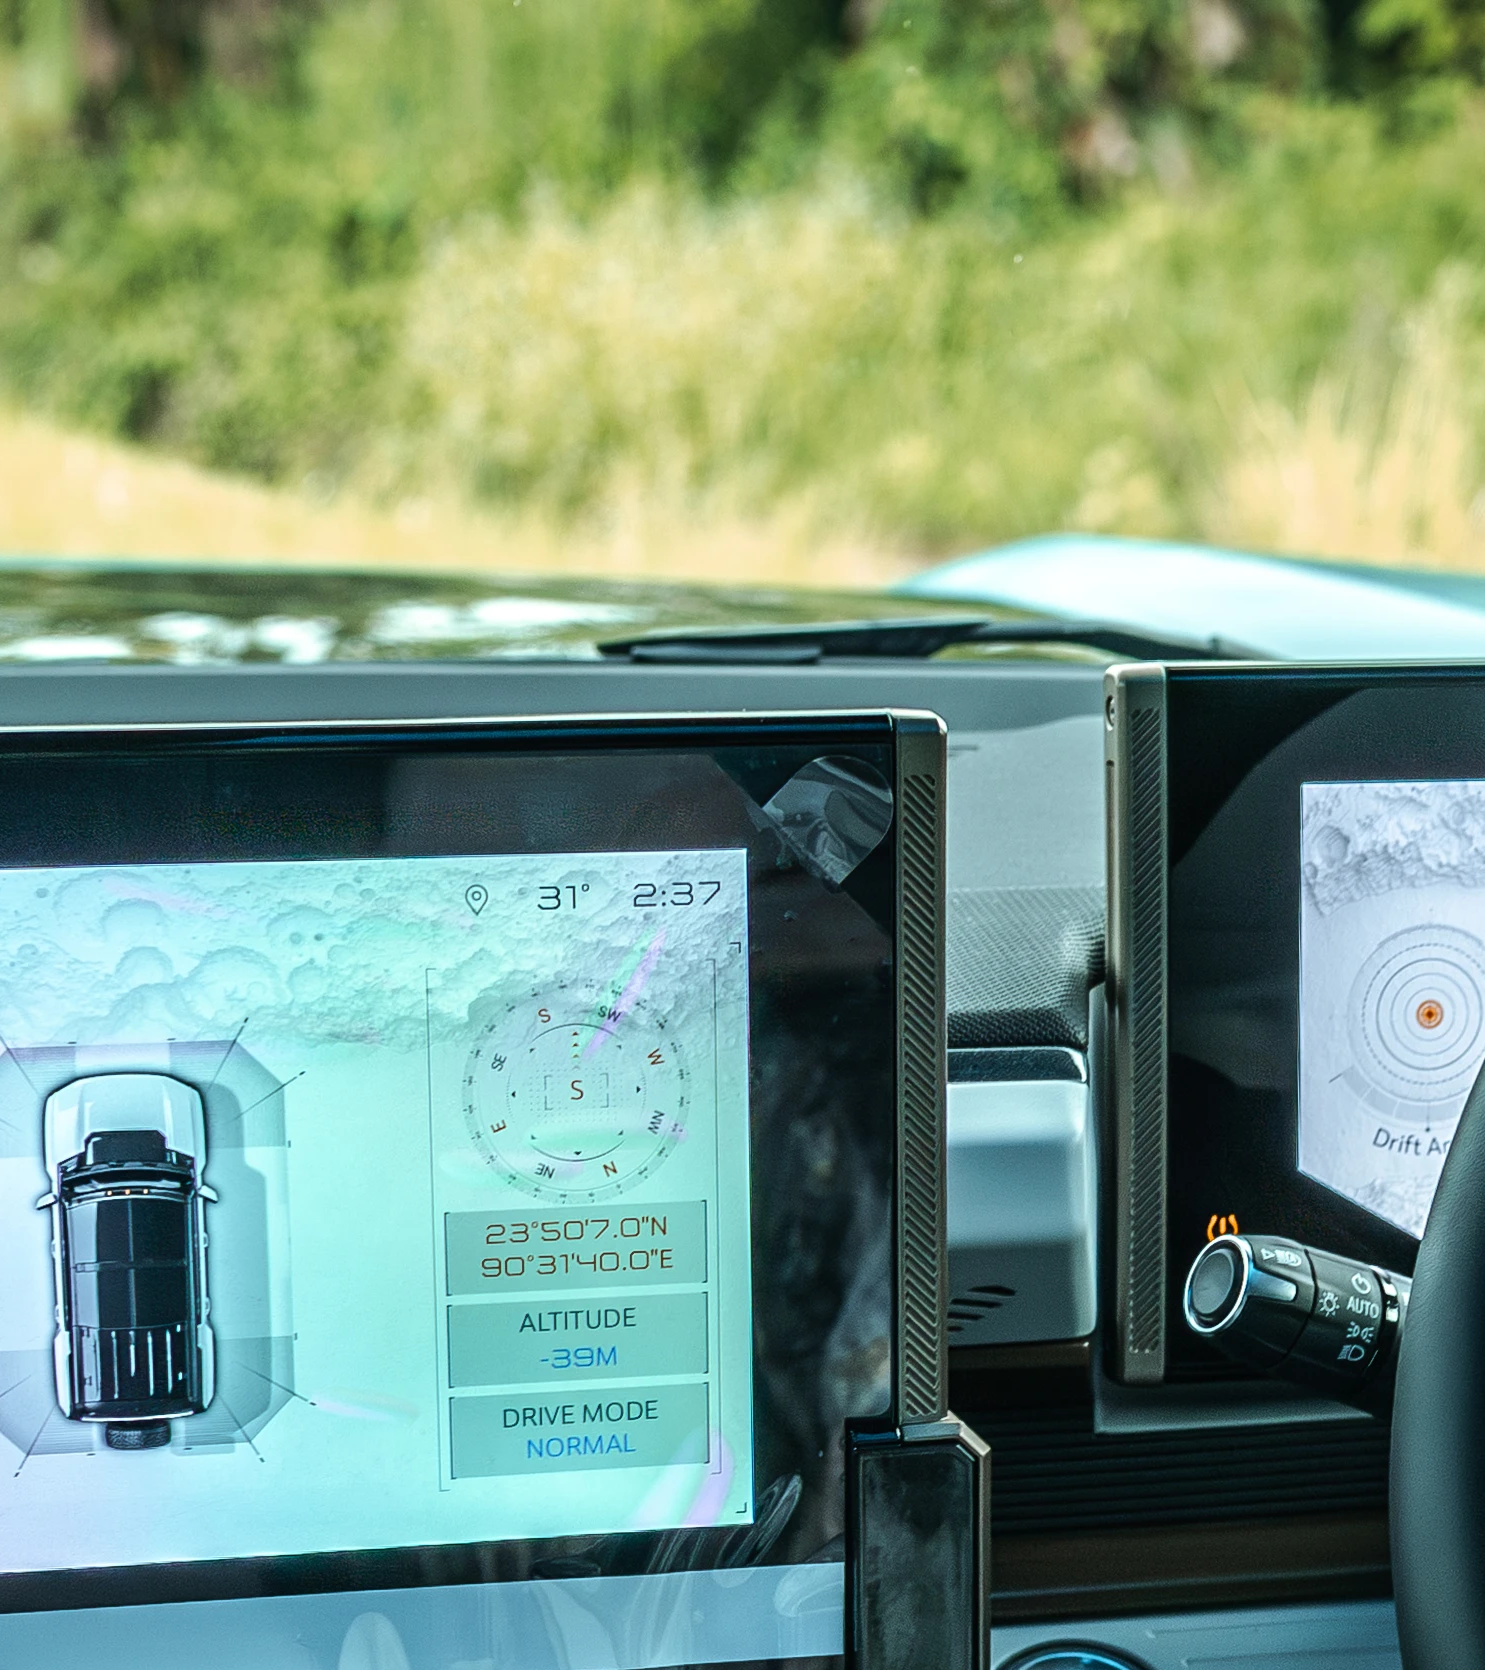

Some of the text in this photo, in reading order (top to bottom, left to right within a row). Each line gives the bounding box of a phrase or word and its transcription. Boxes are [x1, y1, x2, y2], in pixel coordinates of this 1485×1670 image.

[536, 883, 591, 911] 31°
[632, 880, 722, 908] 2:37
[538, 1008, 552, 1024] S
[597, 1005, 622, 1023] SW
[569, 1079, 584, 1101] S
[490, 1120, 507, 1133] E
[1372, 1127, 1422, 1156] Drift
[603, 1161, 619, 1177] N
[1346, 1296, 1380, 1319] AUTO
[519, 1307, 637, 1333] ALTITUDE
[539, 1346, 618, 1370] -39M
[502, 1400, 659, 1429] DRIVE MODE
[526, 1434, 637, 1459] NORMAL
